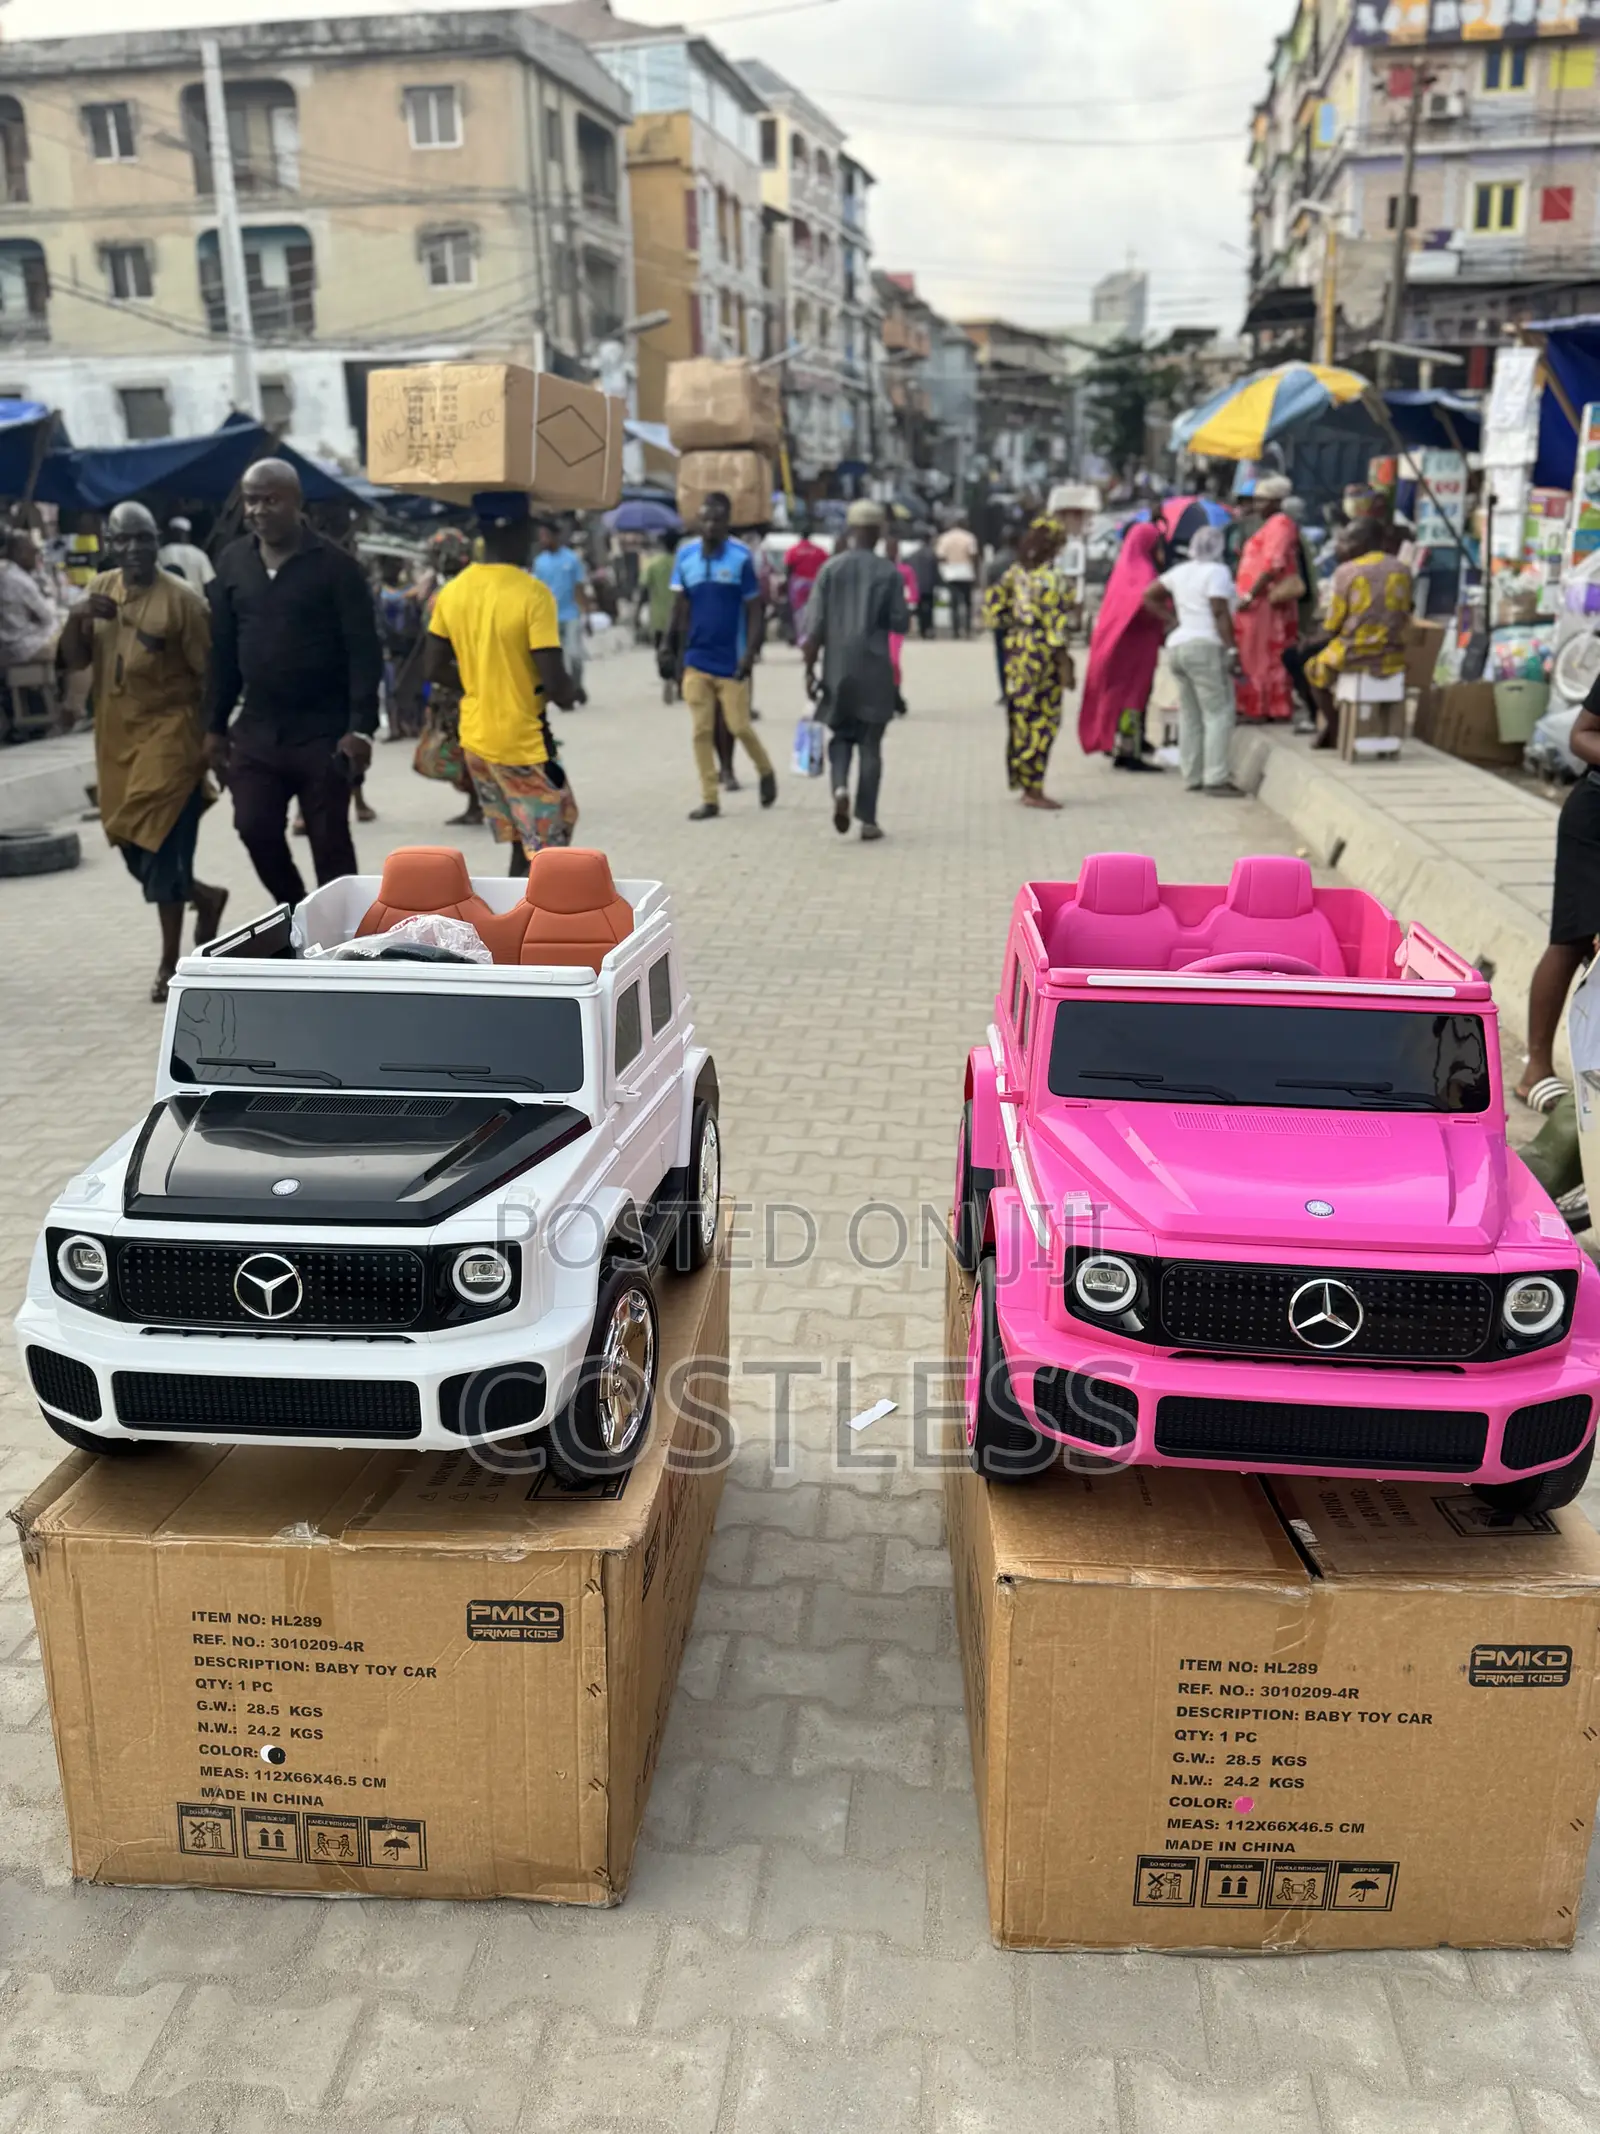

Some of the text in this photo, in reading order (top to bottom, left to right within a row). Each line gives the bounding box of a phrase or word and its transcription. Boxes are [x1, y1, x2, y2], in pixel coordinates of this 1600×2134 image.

[191, 1611, 323, 1628] ITEM NO: HL289
[471, 1605, 560, 1623] PMKD
[523, 1629, 558, 1639] KIDS
[192, 1633, 365, 1652] REF. NO.: 3010209-4R
[194, 1655, 437, 1678] DESCRIPTION: BABY TOY CAR
[1475, 1650, 1568, 1667] PMKD
[1179, 1659, 1318, 1675] ITEM NO: HL289
[195, 1678, 273, 1693] QTY: 1 PC
[1527, 1674, 1564, 1683] KIDS
[1178, 1682, 1360, 1699] REF. NO.: 3010209-4R
[196, 1700, 324, 1718] G.W.: 28.5 KGS
[1176, 1706, 1433, 1725] DESCRIPTION: BABY TOY CAR
[197, 1722, 324, 1740] N.W.: 24.2 KGS
[1174, 1729, 1257, 1743] QTY: 1 PC
[199, 1744, 258, 1758] COLOR:
[1172, 1752, 1307, 1767] G.W.: 28.5 KGS
[200, 1766, 387, 1788] MEAS: 112X66X46.5 CM
[1170, 1775, 1305, 1789] N.W.: 24.2 KGS
[201, 1787, 325, 1807] MADE IN CHINA
[1169, 1796, 1232, 1809] COLOR:
[1167, 1818, 1365, 1834] MEAS: 112X66X46.5 CM
[1165, 1839, 1296, 1853] MADE IN CHINA
